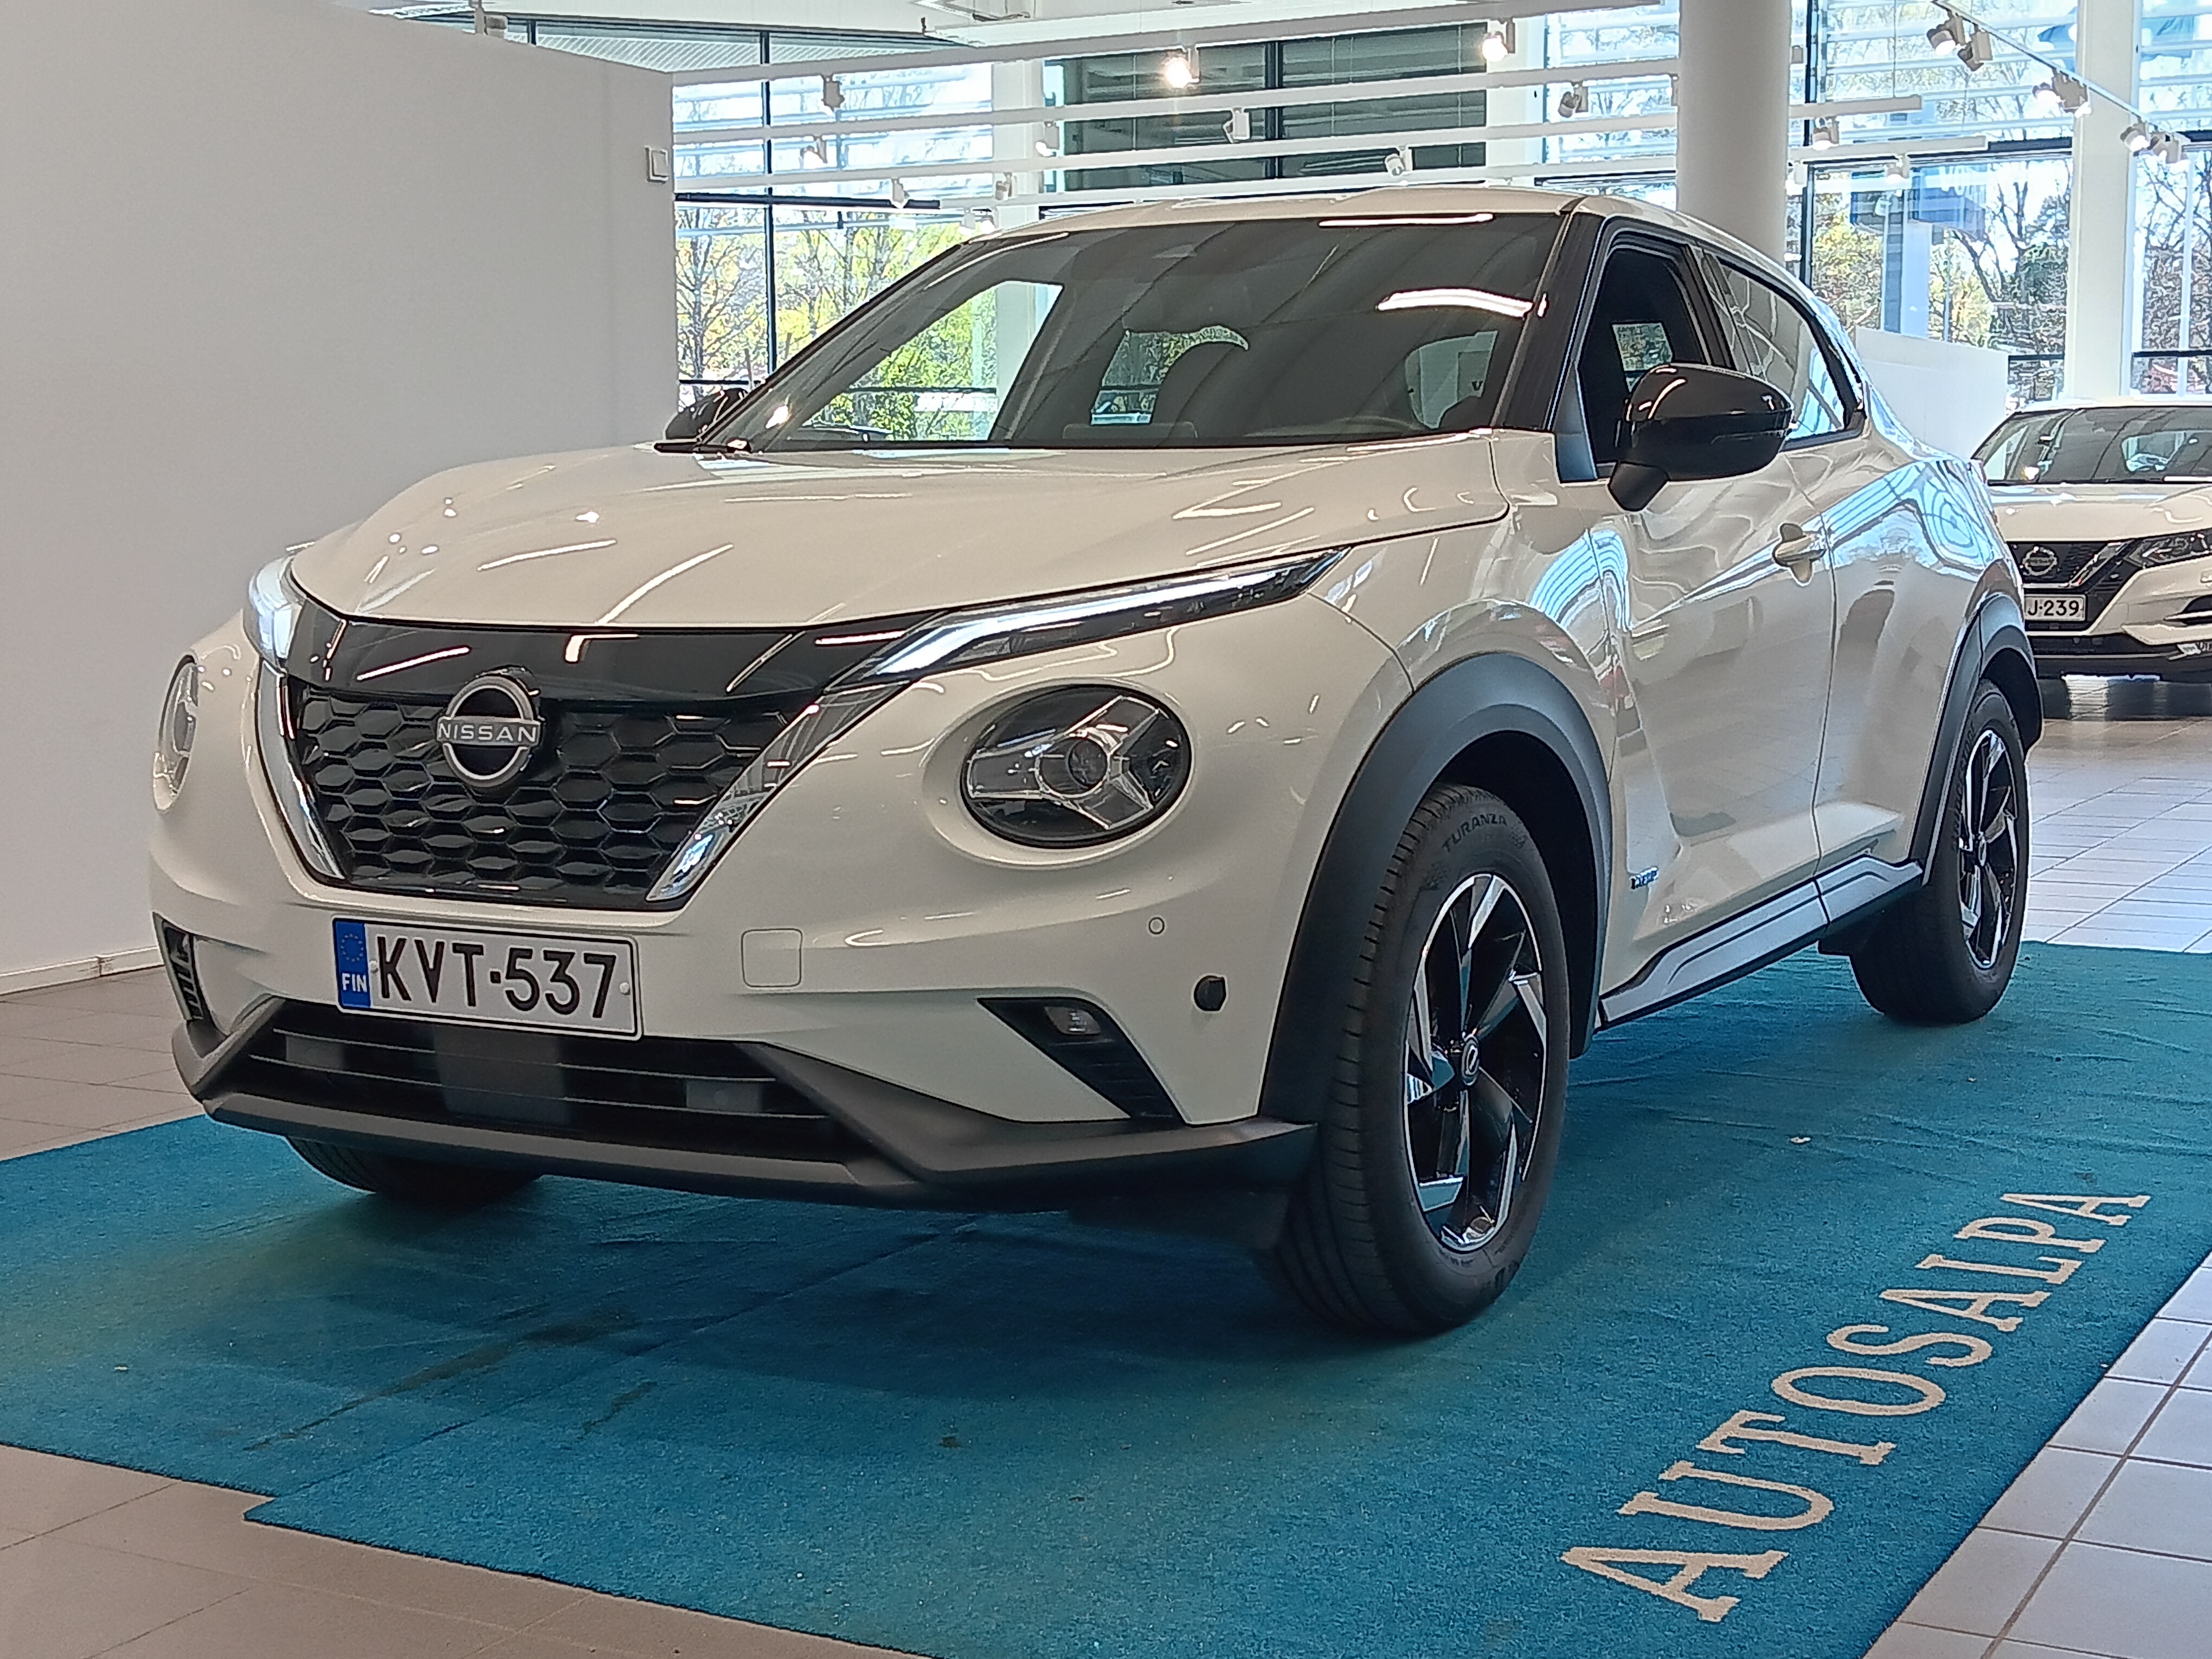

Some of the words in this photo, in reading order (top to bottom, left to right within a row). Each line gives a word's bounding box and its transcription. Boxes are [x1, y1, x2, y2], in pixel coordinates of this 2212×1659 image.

[438, 722, 536, 742] NISSAN
[1442, 813, 1508, 853] TURANZA
[342, 973, 368, 993] FIN
[1559, 1193, 2151, 1622] AUTOSALPA
